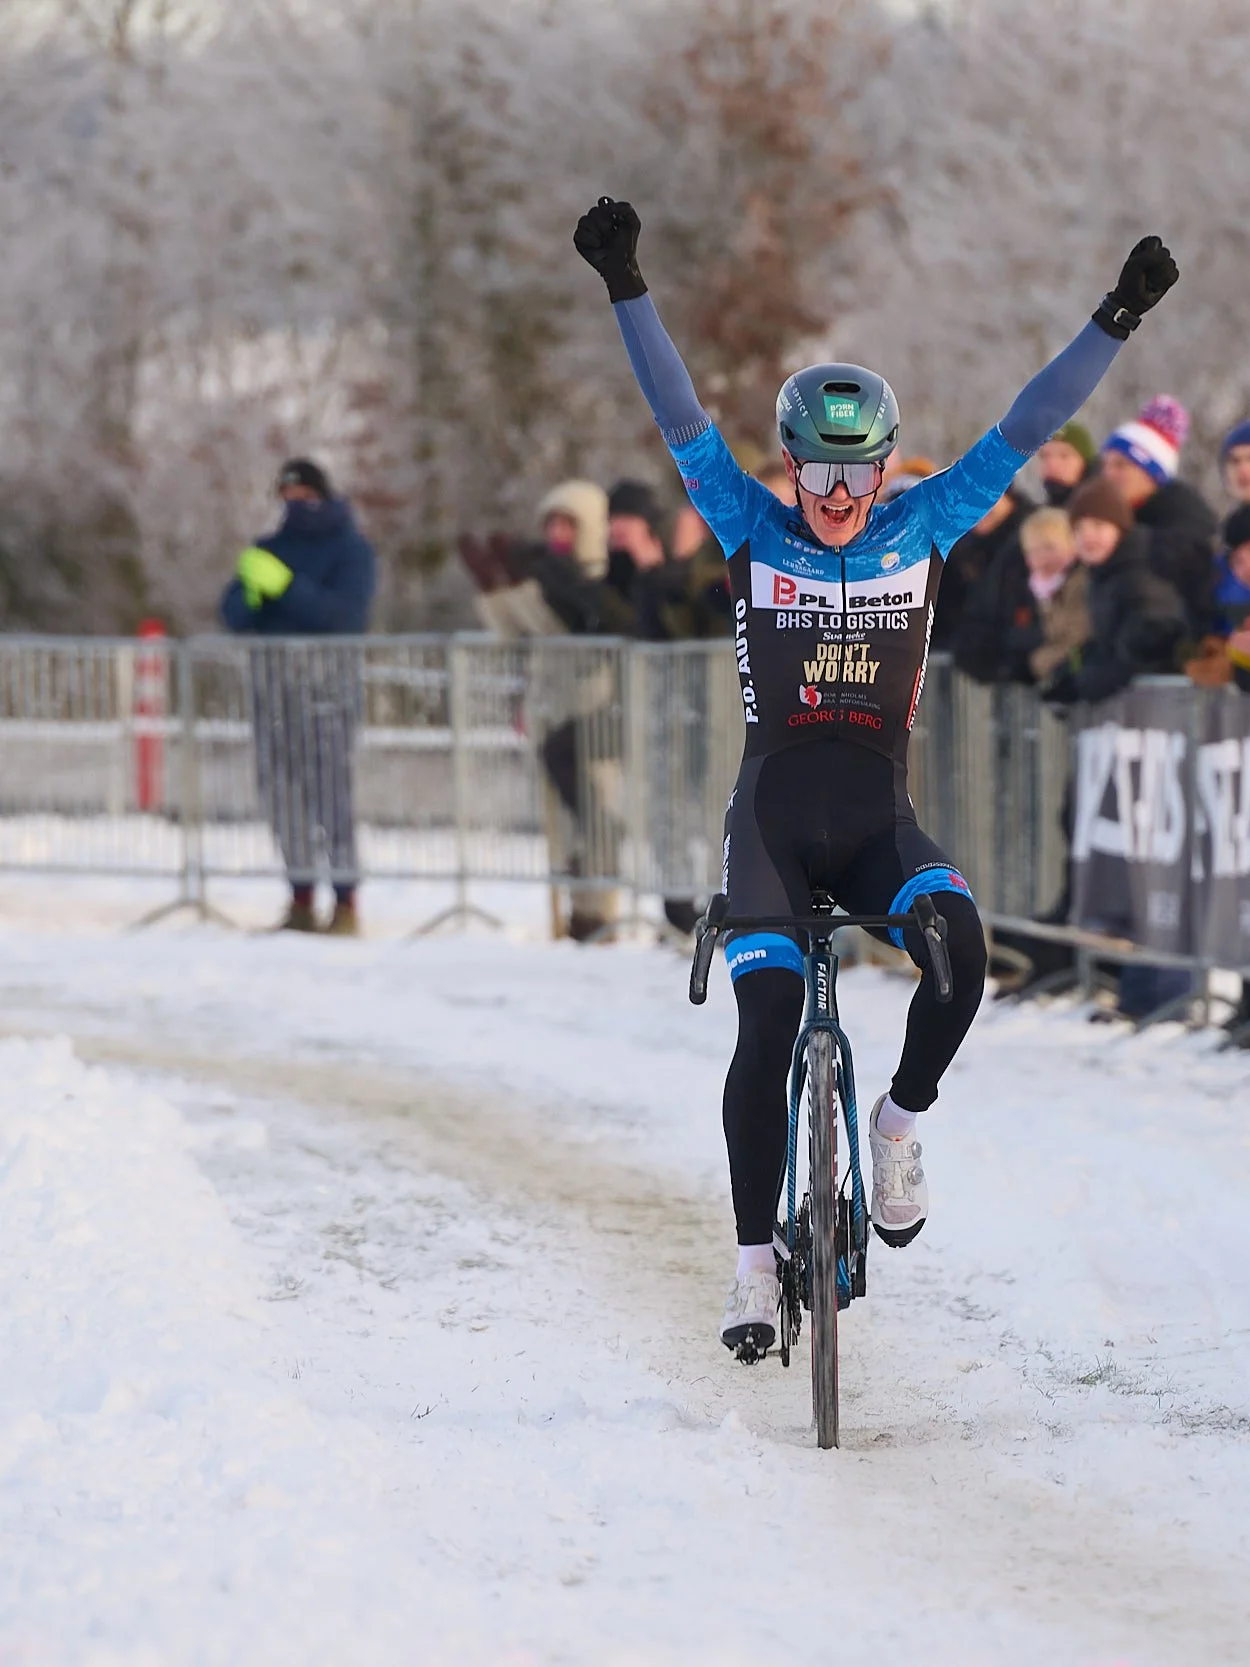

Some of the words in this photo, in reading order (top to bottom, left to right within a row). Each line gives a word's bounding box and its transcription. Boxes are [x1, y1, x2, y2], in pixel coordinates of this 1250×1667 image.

[829, 403, 855, 411] BORN
[830, 410, 855, 419] FIBER
[798, 593, 835, 609] PL
[848, 591, 913, 609] Beton
[776, 611, 813, 629] BHS
[735, 598, 751, 674] AUTO
[816, 643, 871, 661] DON'T
[803, 660, 880, 684] WORRY
[742, 679, 759, 723] P.O.
[848, 711, 882, 730] BERG
[728, 949, 767, 969] eton
[817, 962, 827, 1010] FACTOR
